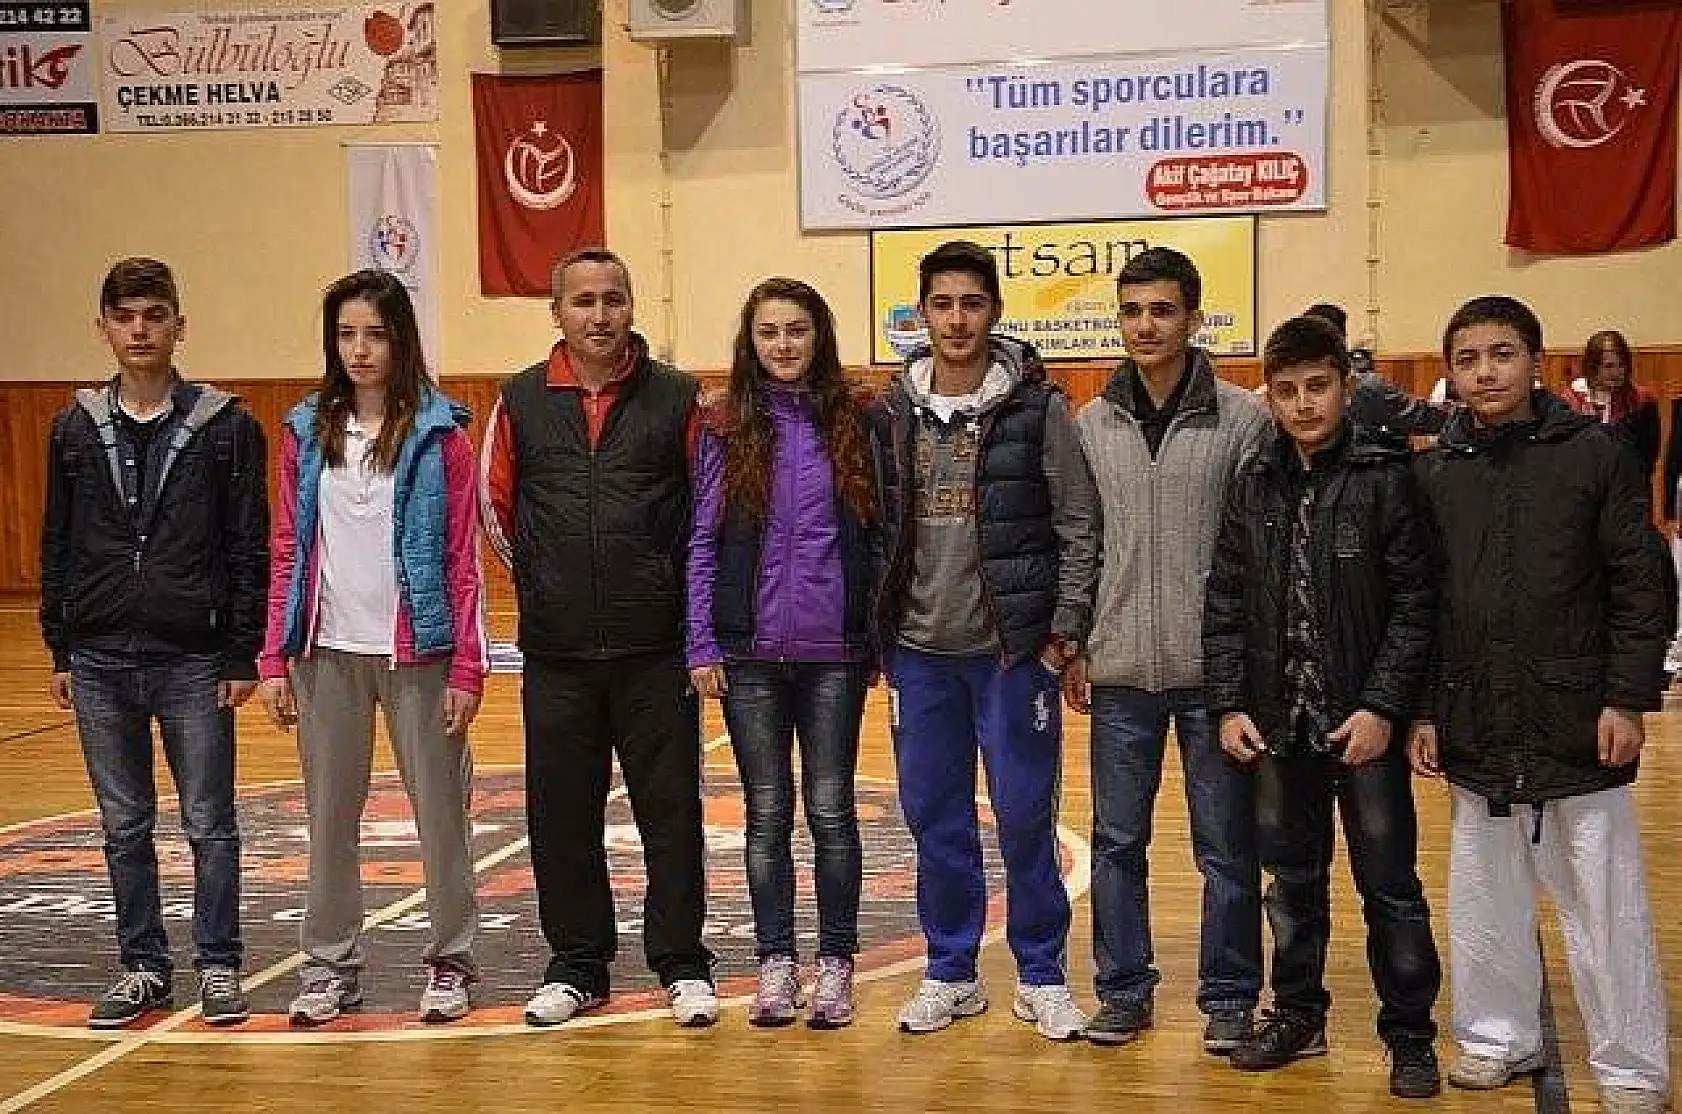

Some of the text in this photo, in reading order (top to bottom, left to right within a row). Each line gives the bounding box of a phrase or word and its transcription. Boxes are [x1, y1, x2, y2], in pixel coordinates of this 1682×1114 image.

[109, 24, 352, 83] Bülbüloğlu
[117, 81, 281, 113] ÇEKME HELVA
[1071, 65, 1270, 116] sporculara
[968, 120, 1131, 167] başarılar
[988, 232, 1149, 278] tsam
